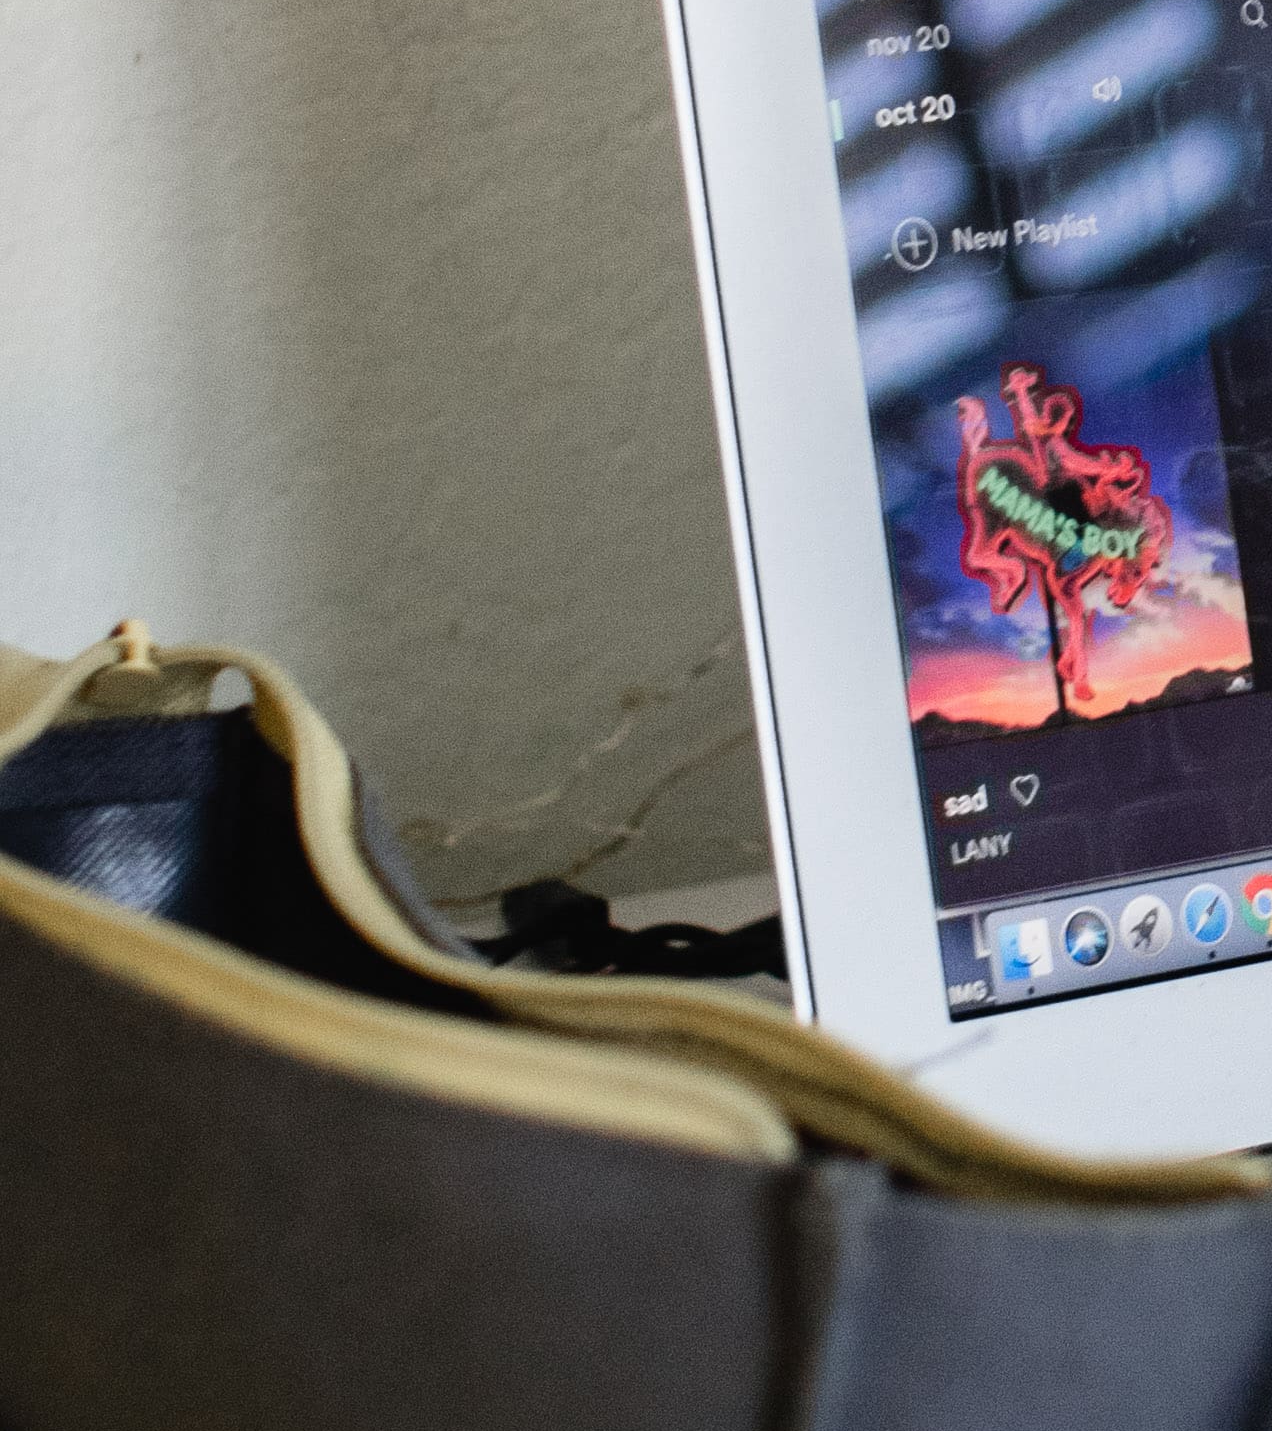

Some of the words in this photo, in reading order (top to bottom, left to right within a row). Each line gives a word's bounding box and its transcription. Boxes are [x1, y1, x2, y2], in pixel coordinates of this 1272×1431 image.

[867, 34, 912, 59] nov
[915, 24, 951, 52] 20
[875, 98, 918, 129] oct
[920, 93, 957, 124] 20
[950, 226, 1008, 255] New
[1011, 212, 1100, 248] Playlist
[976, 467, 1081, 551] MAMA'S
[1081, 524, 1147, 560] BOY
[943, 784, 989, 818] sad
[949, 832, 1013, 866] LANY
